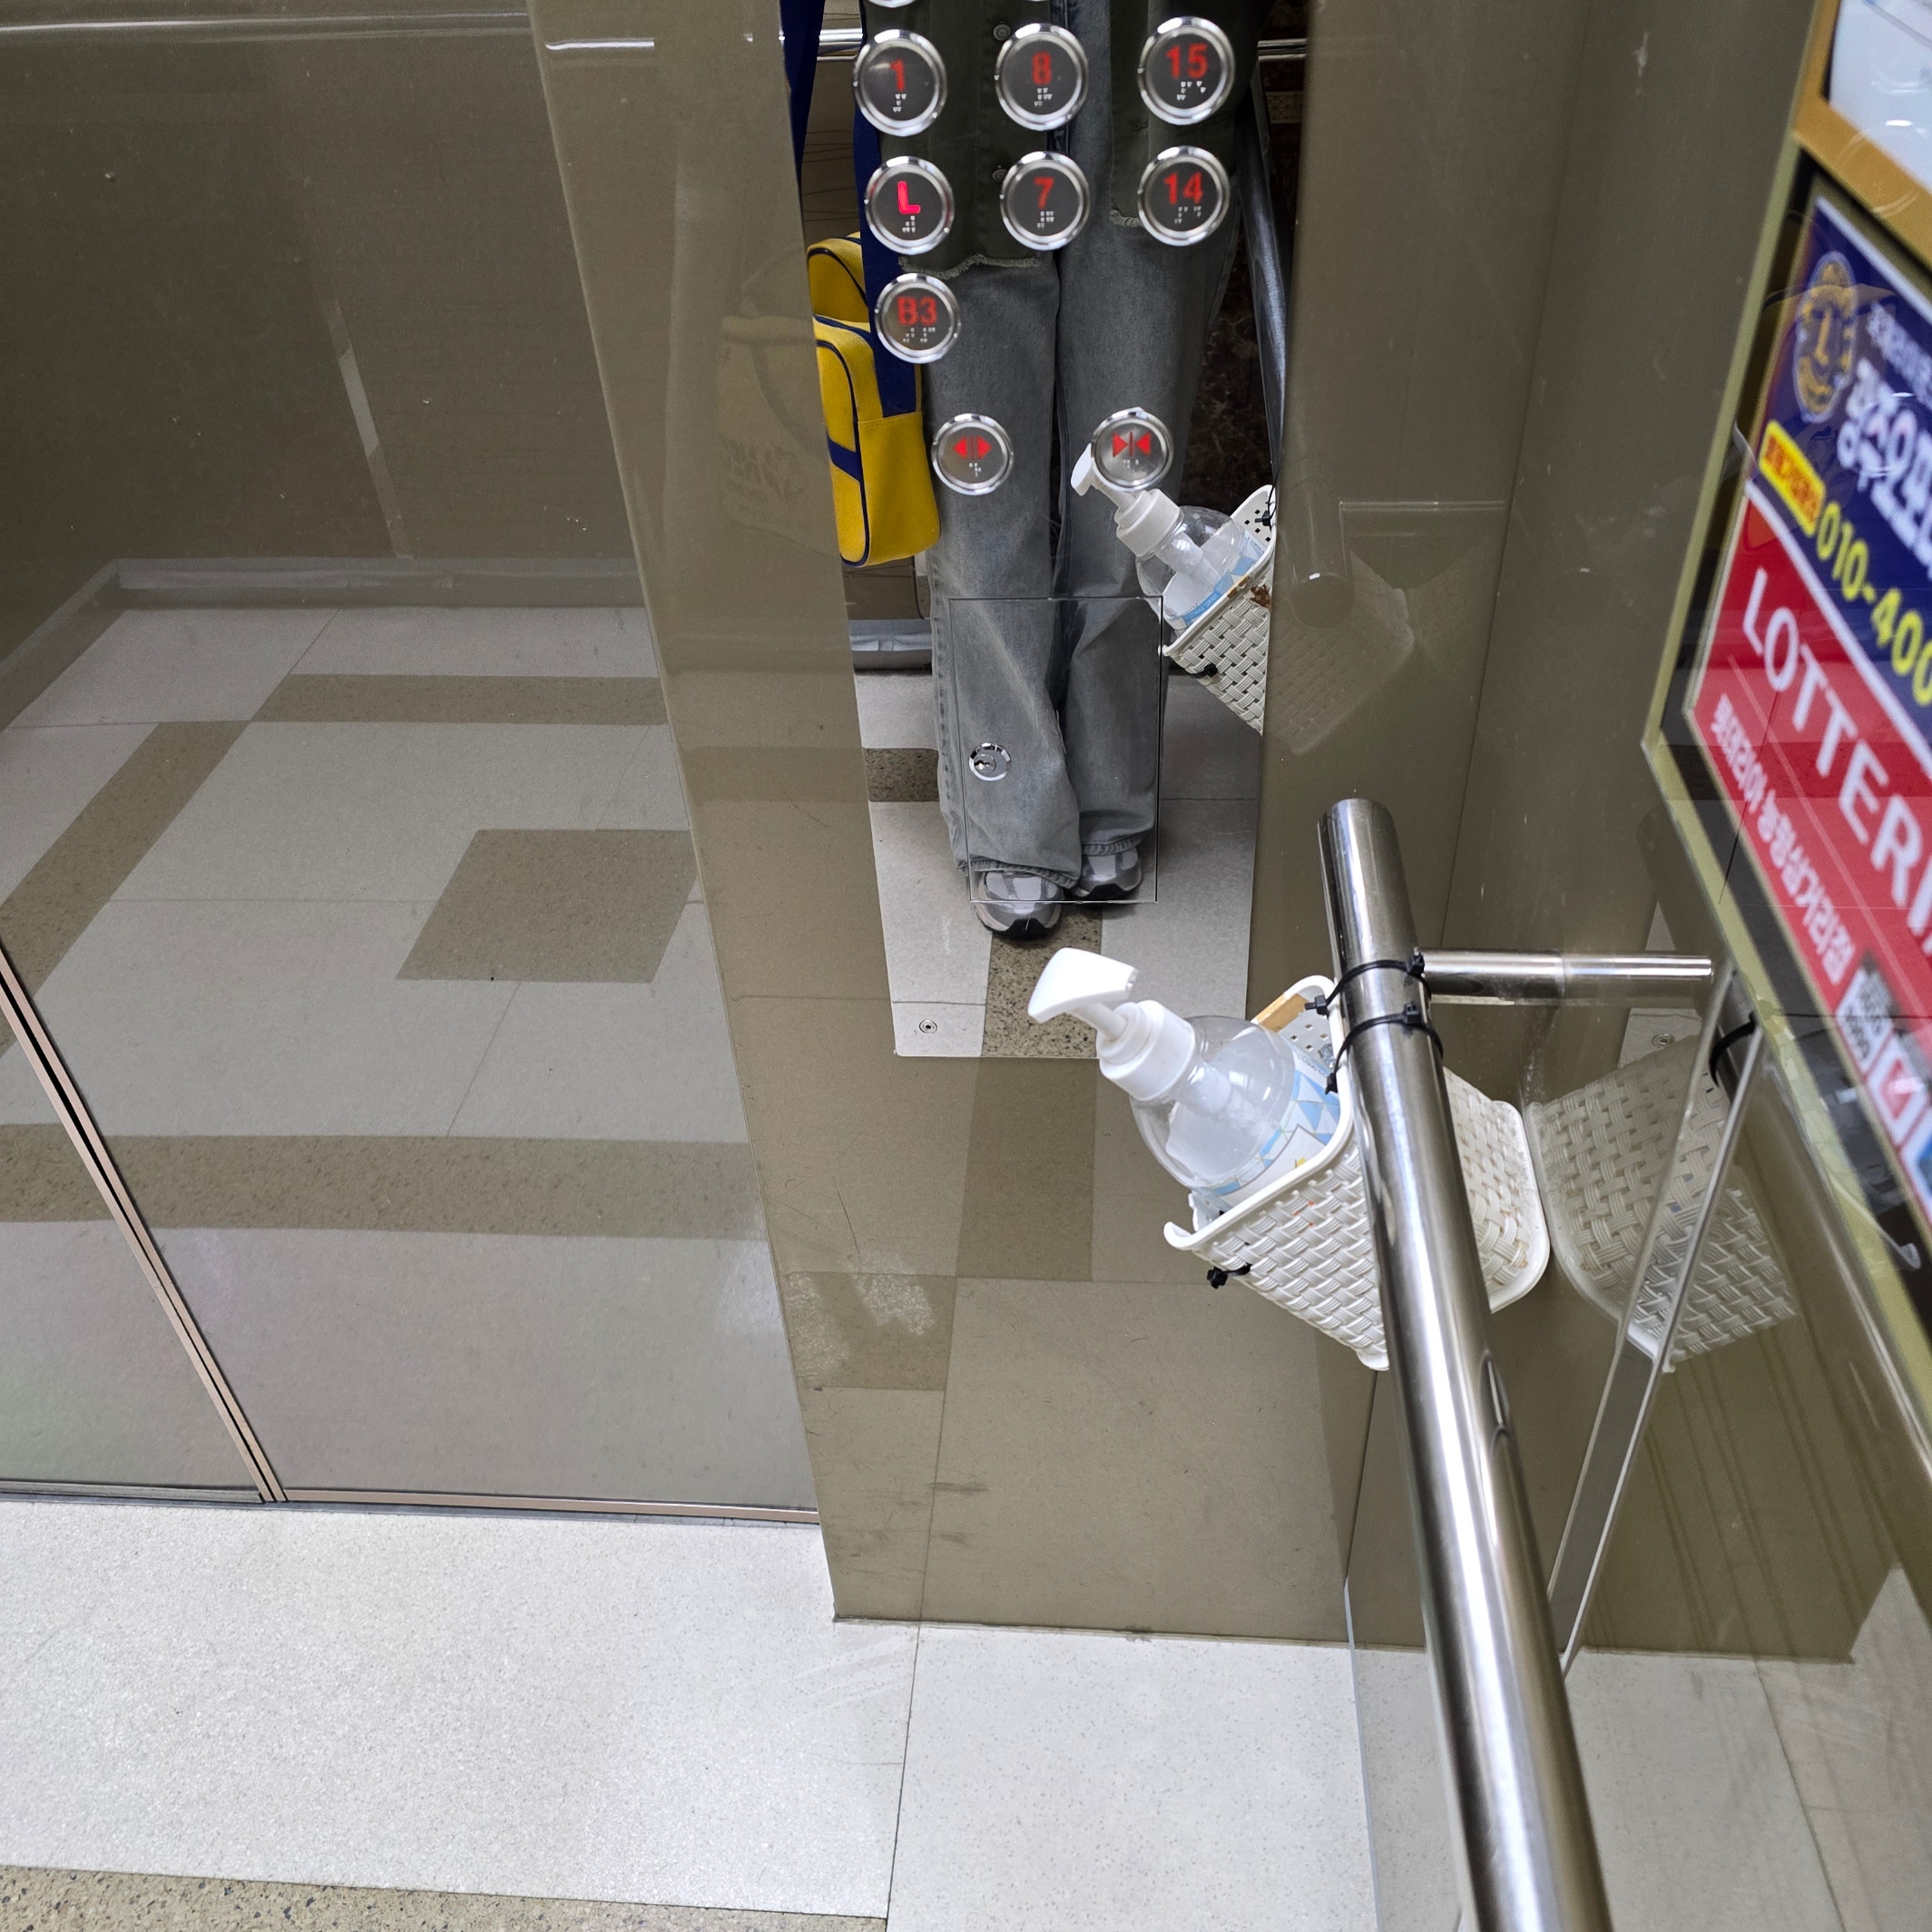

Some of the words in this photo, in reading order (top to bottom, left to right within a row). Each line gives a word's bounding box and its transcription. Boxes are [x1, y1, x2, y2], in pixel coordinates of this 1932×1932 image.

[889, 58, 906, 92] 1
[1032, 51, 1053, 85] 8
[1165, 43, 1209, 79] 15
[896, 181, 922, 215] L
[1034, 176, 1054, 209] 7
[1163, 172, 1204, 205] 14
[897, 296, 937, 327] B3
[1742, 564, 1932, 958] LOTTERI
